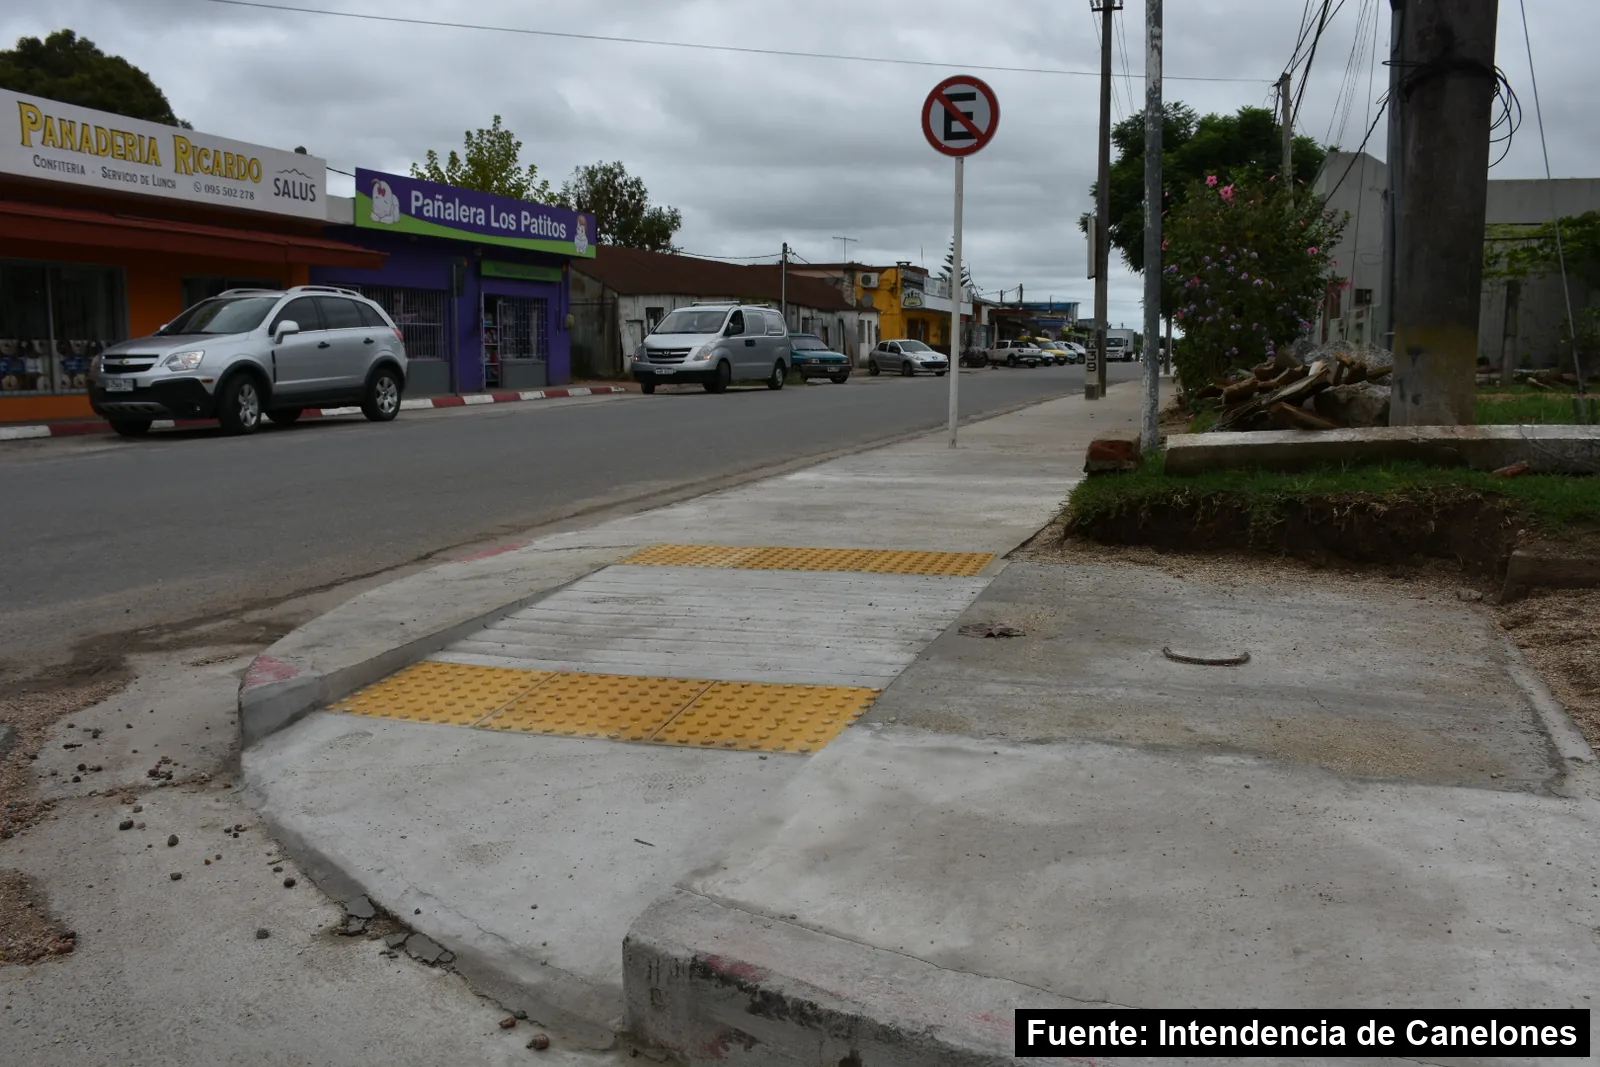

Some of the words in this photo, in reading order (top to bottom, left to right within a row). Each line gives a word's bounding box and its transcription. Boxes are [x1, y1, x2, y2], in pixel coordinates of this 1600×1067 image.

[943, 91, 977, 141] E
[172, 134, 263, 184] RICARDO
[204, 183, 221, 195] 095
[222, 186, 238, 198] 502
[239, 189, 255, 201] 278
[273, 177, 316, 203] SALUS
[410, 190, 486, 227] Pañalera
[490, 204, 517, 231] Los
[520, 210, 567, 239] Patitos
